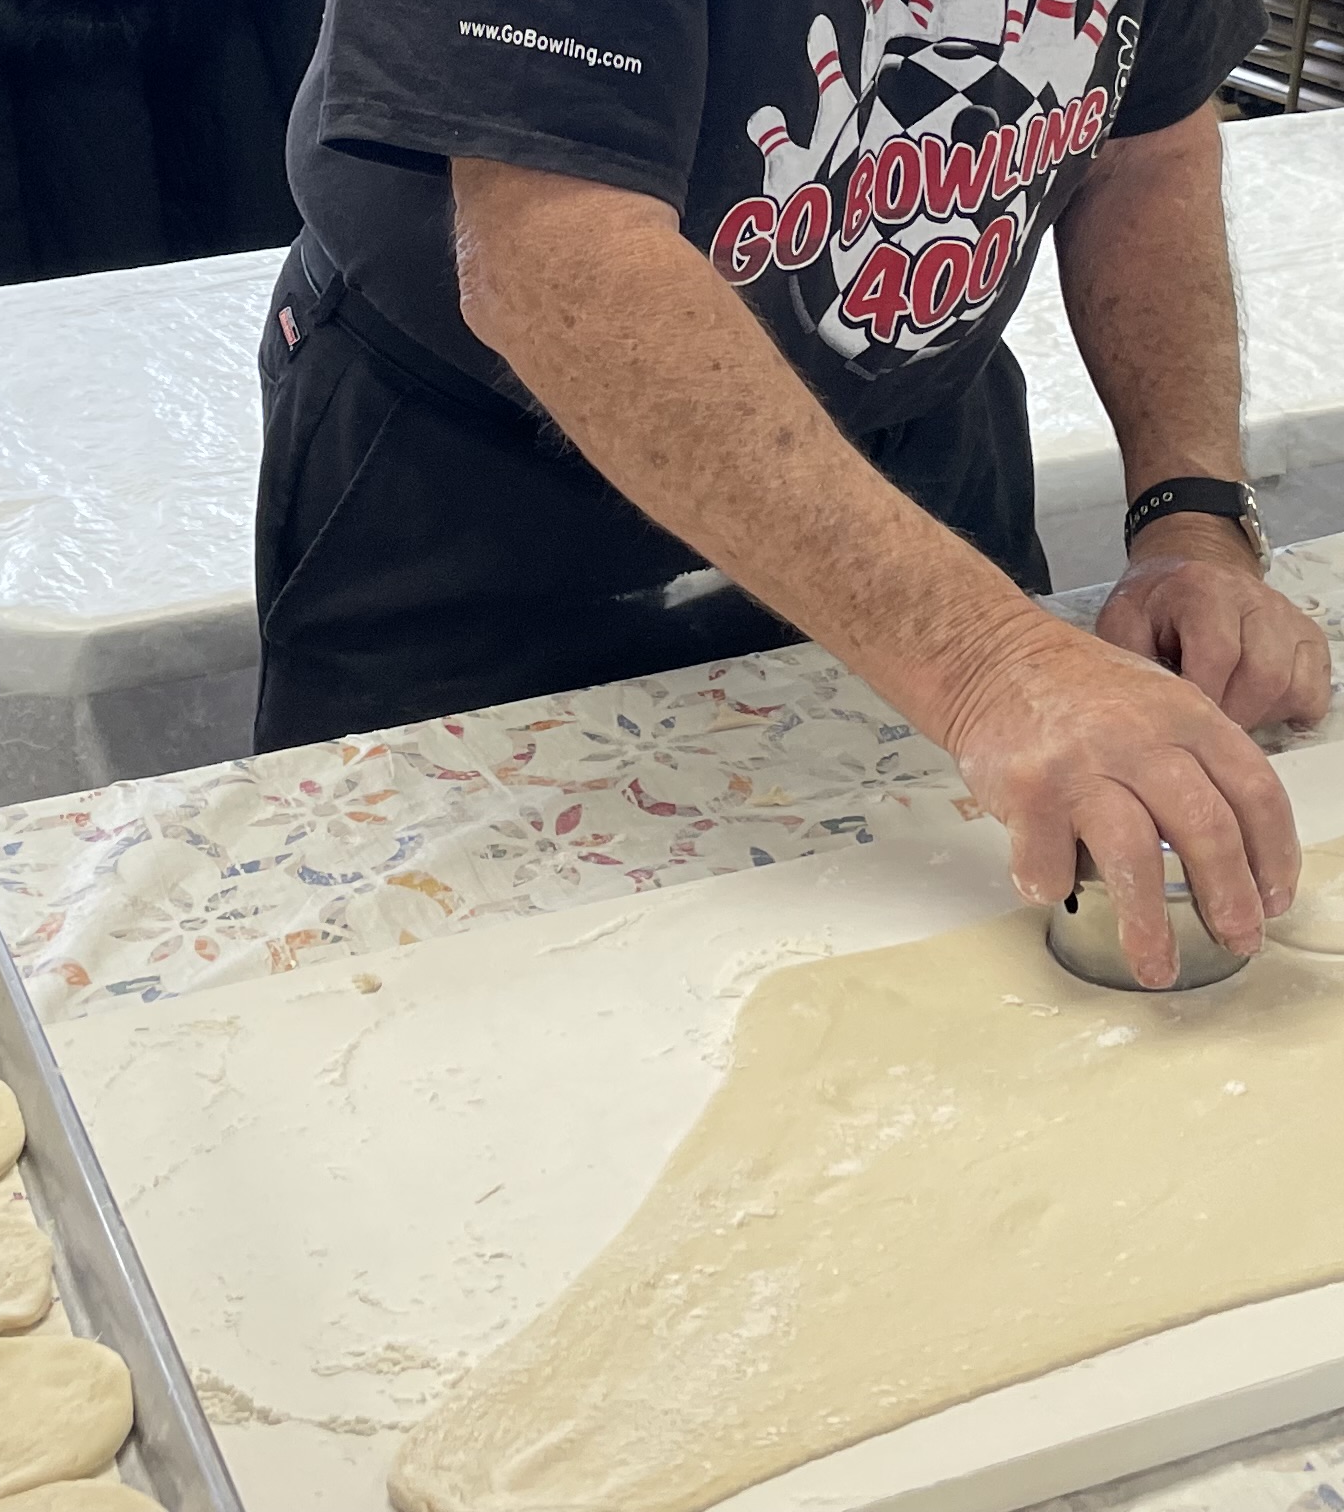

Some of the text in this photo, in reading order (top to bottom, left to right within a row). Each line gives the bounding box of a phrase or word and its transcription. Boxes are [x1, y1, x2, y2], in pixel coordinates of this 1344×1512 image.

[459, 20, 642, 74] www.GoBowling.com
[710, 86, 1108, 286] GO BOWLING
[843, 217, 1016, 344] 400
